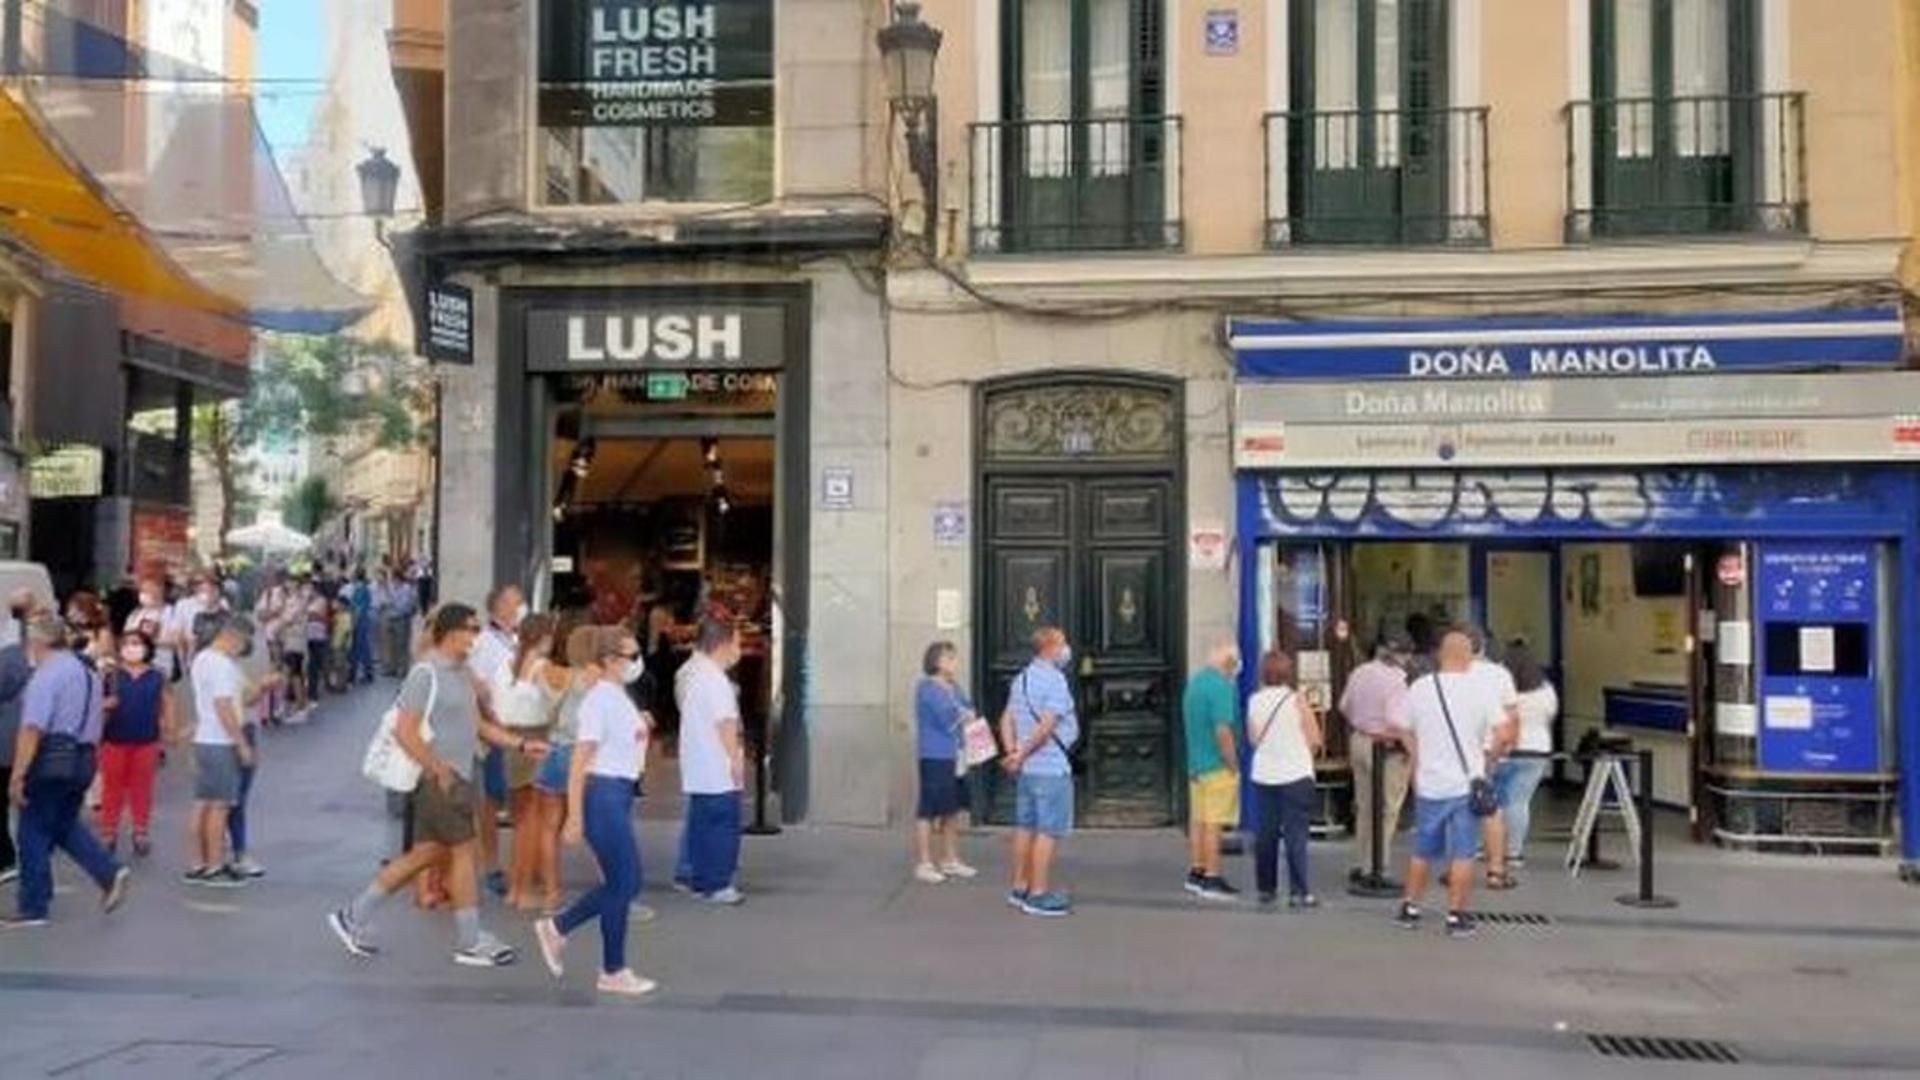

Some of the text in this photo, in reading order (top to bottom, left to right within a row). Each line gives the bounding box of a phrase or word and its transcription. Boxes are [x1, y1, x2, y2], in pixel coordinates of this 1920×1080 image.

[592, 5, 715, 41] LUSH
[593, 45, 715, 77] FRESH
[592, 80, 714, 99] HANDMADE
[592, 101, 715, 120] COSMETICS
[567, 314, 741, 361] LUSH
[1409, 346, 1716, 376] DOÑA MANOLITA
[1346, 387, 1545, 414] Doña Manolita
